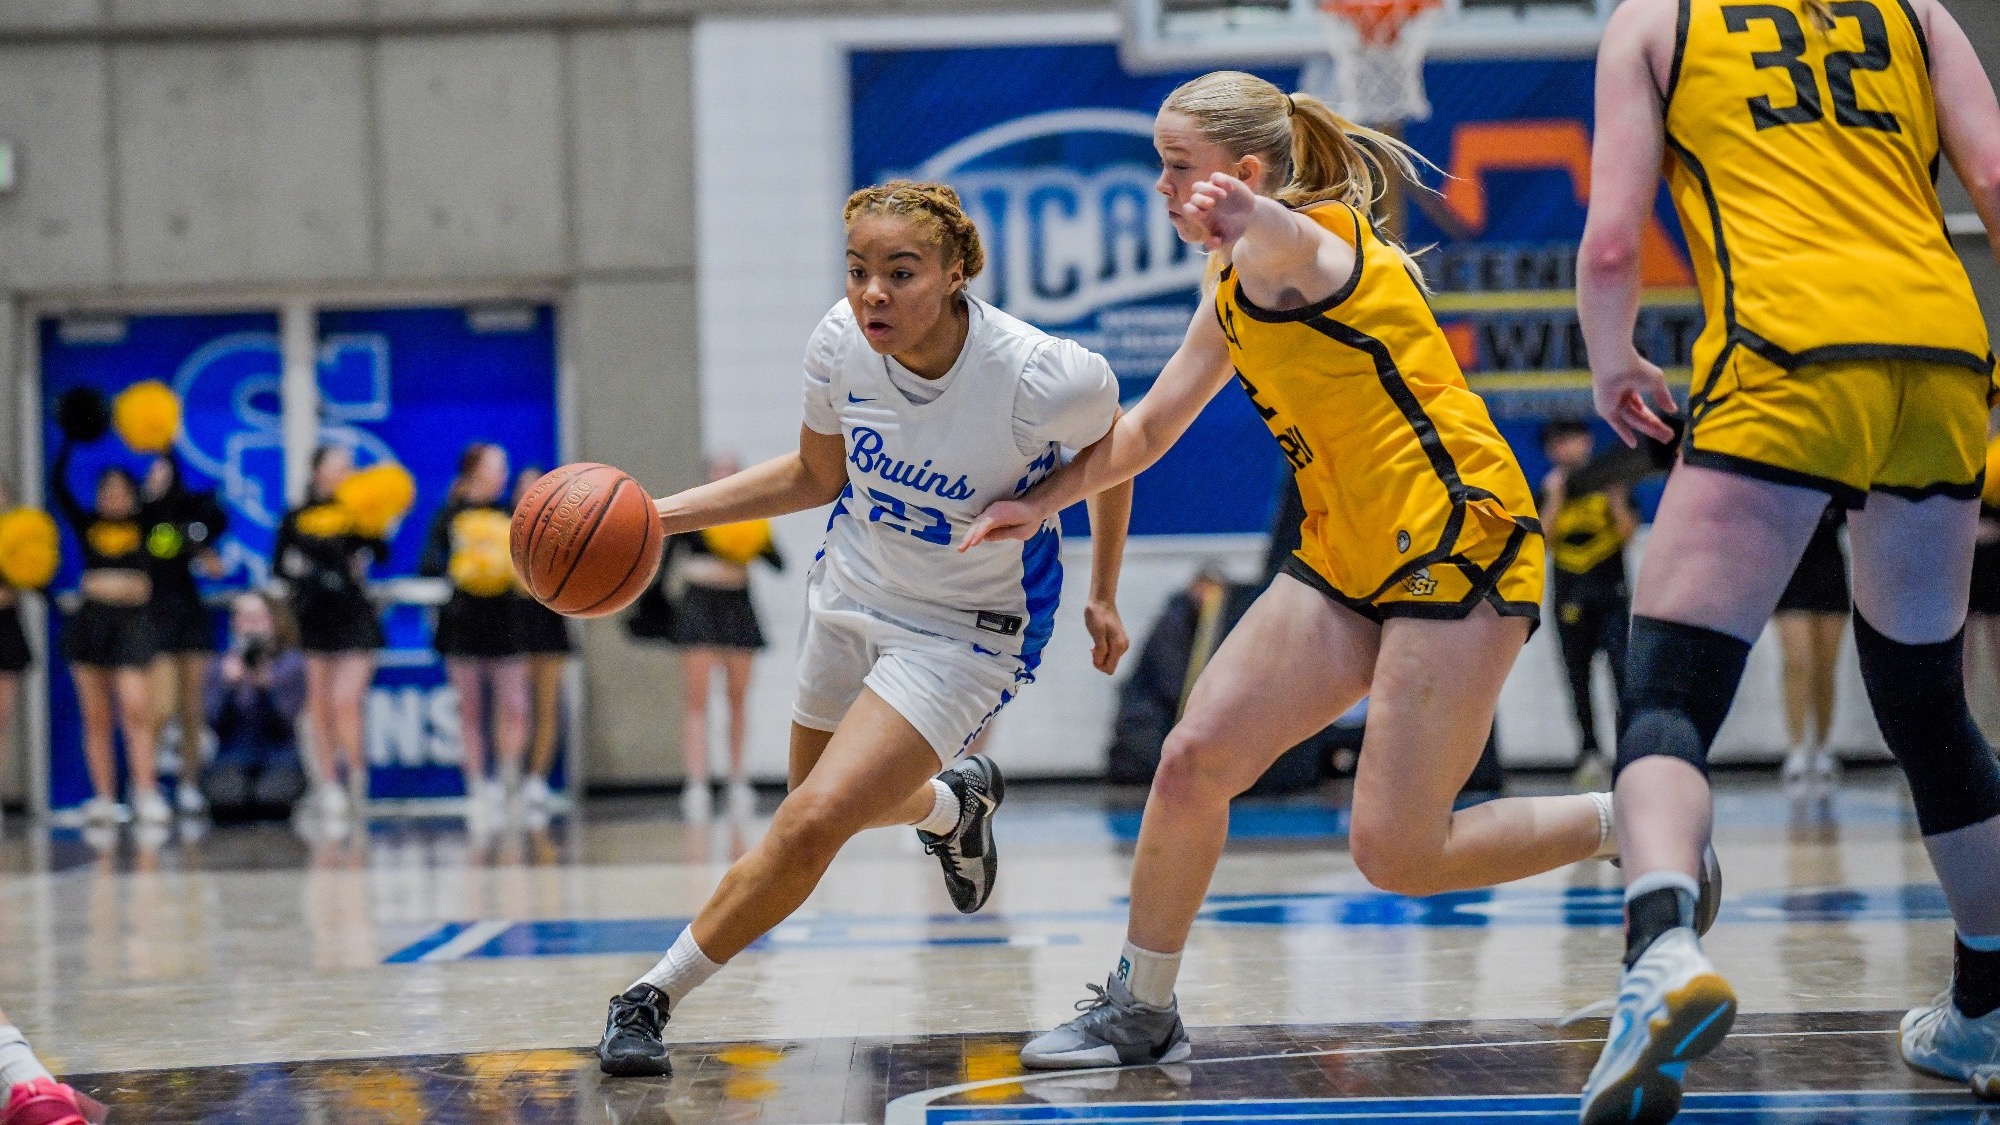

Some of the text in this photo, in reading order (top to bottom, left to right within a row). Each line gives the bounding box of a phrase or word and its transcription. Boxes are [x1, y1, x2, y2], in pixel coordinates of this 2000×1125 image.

[1720, 1, 1902, 134] 32
[1485, 320, 1694, 370] WET
[848, 426, 976, 501] Bruins
